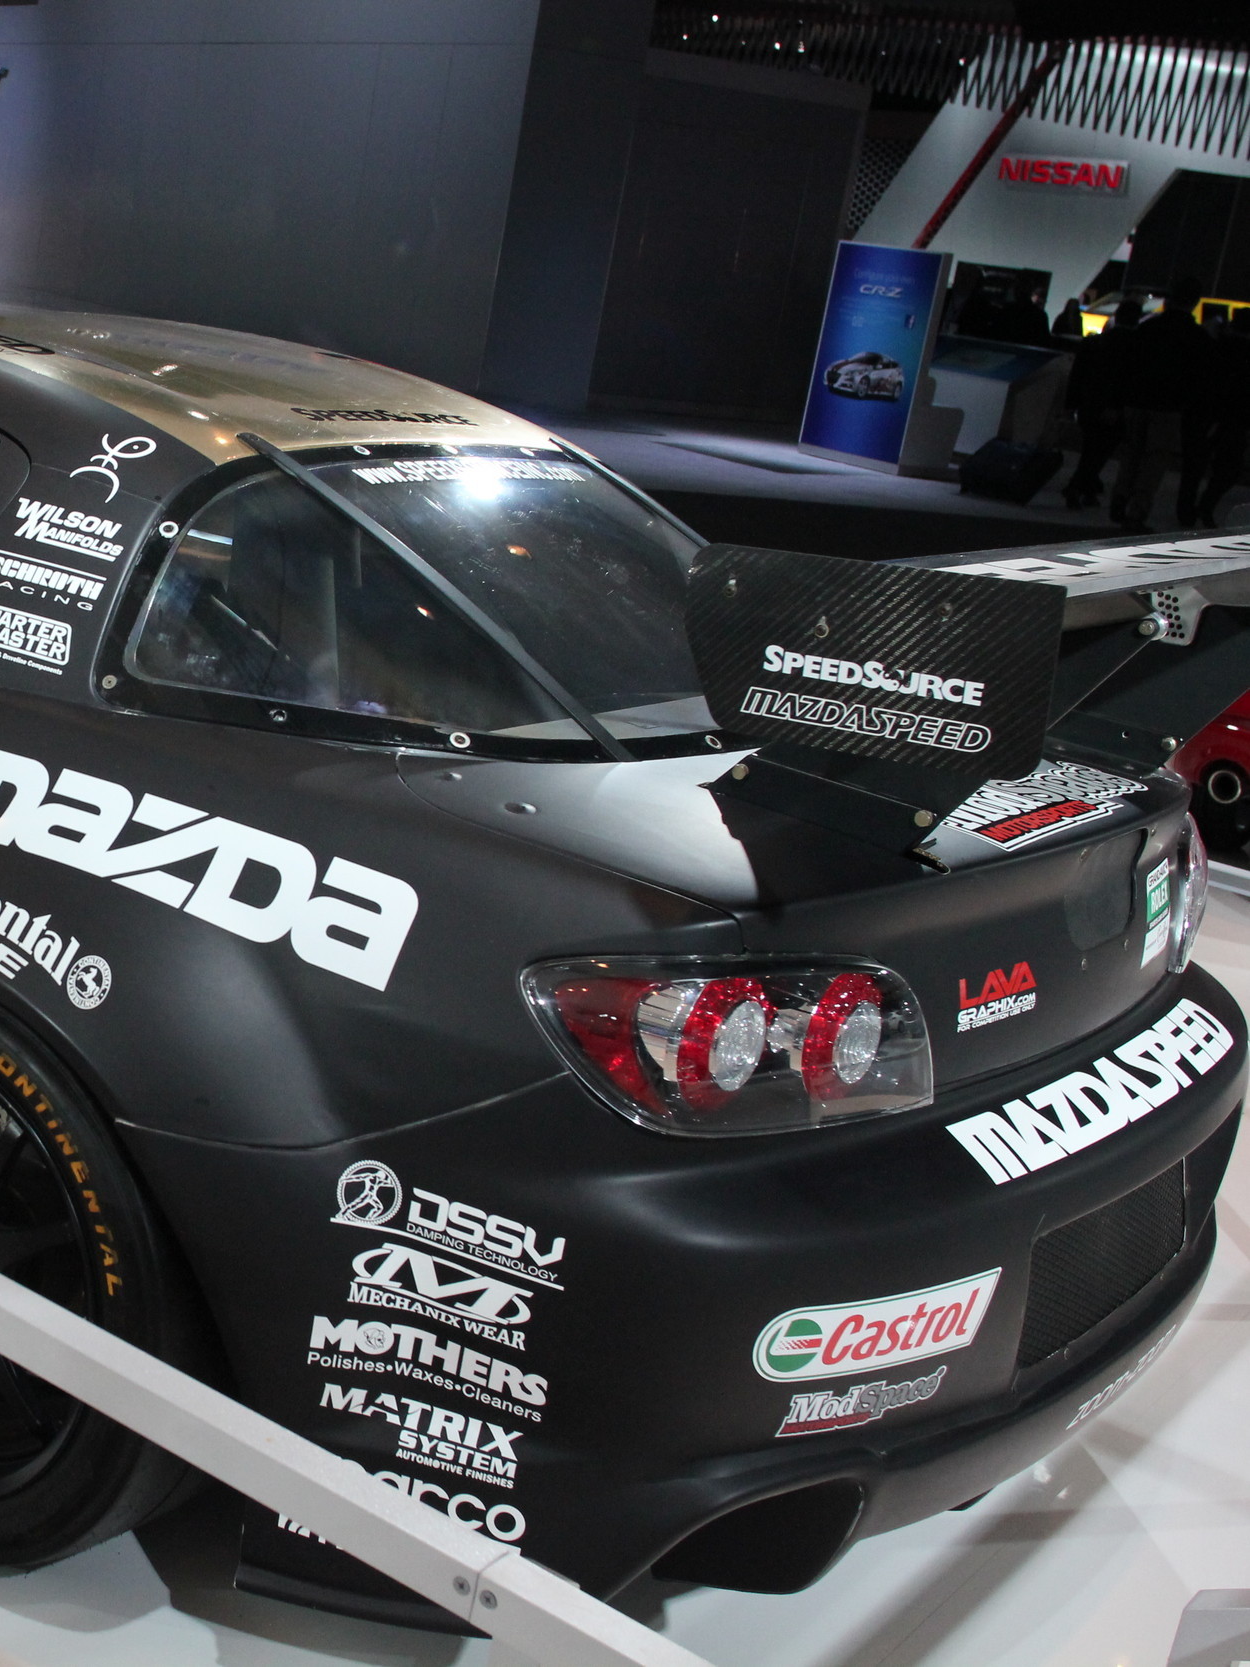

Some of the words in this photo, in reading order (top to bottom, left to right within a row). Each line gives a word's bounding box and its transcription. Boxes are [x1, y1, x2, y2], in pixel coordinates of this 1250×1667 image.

[999, 157, 1124, 189] NISSAN
[14, 519, 124, 556] MANIFOLDS
[15, 497, 123, 539] WILSON
[740, 686, 993, 754] MAZDASPEED
[980, 800, 1097, 841] MOTORSPORTS
[959, 961, 1037, 1010] LAVA
[956, 1023, 971, 1033] FOR
[971, 1012, 1010, 1029] COMPETITION
[1021, 1002, 1036, 1012] ONLY
[945, 998, 1234, 1186] MAZDASPEED
[406, 1222, 465, 1250] DAMPING
[467, 1244, 559, 1283] TECHNOLOGY
[408, 1187, 566, 1267] DSSV
[347, 1281, 460, 1329] MECHANIX
[464, 1320, 526, 1351] WEAR
[822, 1287, 980, 1366] Castrol
[310, 1315, 549, 1407] MOTHERS
[319, 1382, 524, 1462] MATRIX
[786, 1374, 940, 1425] ModSpace
[395, 1448, 464, 1476] AUTOMOTIVE
[464, 1468, 515, 1490] FINISHES
[397, 1429, 518, 1479] SYSTEM
